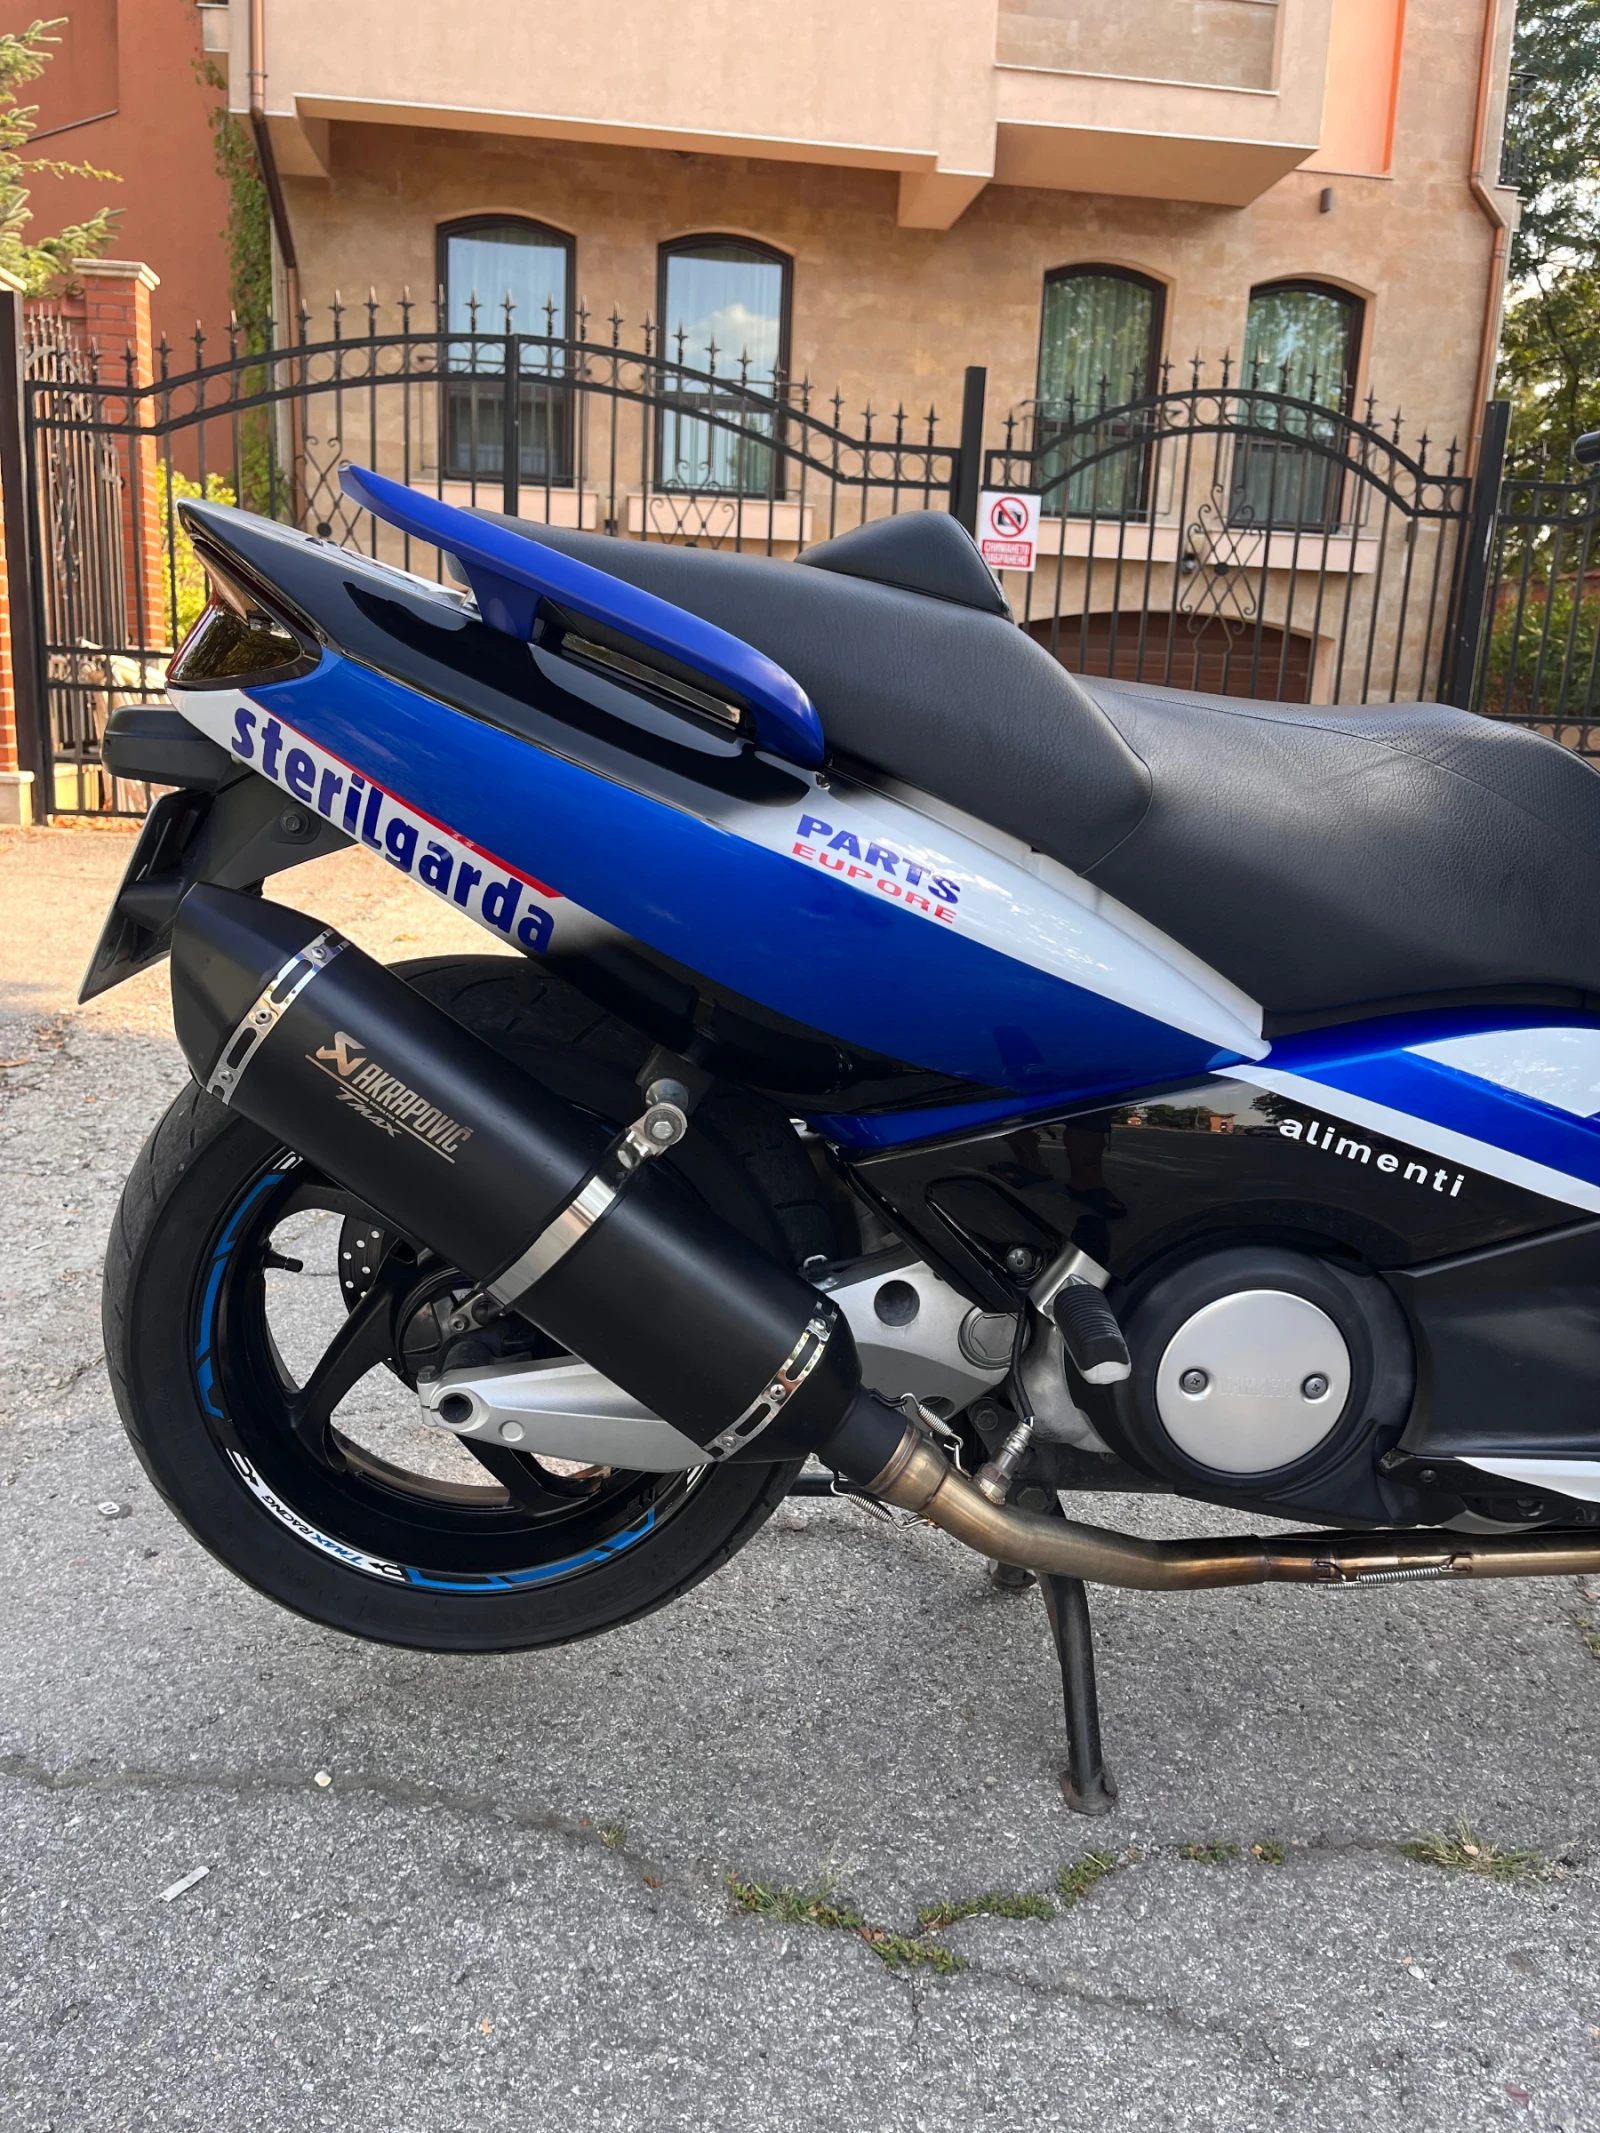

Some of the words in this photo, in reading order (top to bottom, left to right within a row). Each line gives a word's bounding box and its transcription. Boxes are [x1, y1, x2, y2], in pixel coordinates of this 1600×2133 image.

[792, 842, 957, 924] EUPORE
[796, 814, 961, 904] PARTS
[1278, 1118, 1465, 1197] alimenti
[261, 1495, 315, 1537] RACING
[310, 1533, 366, 1566] TMAX
